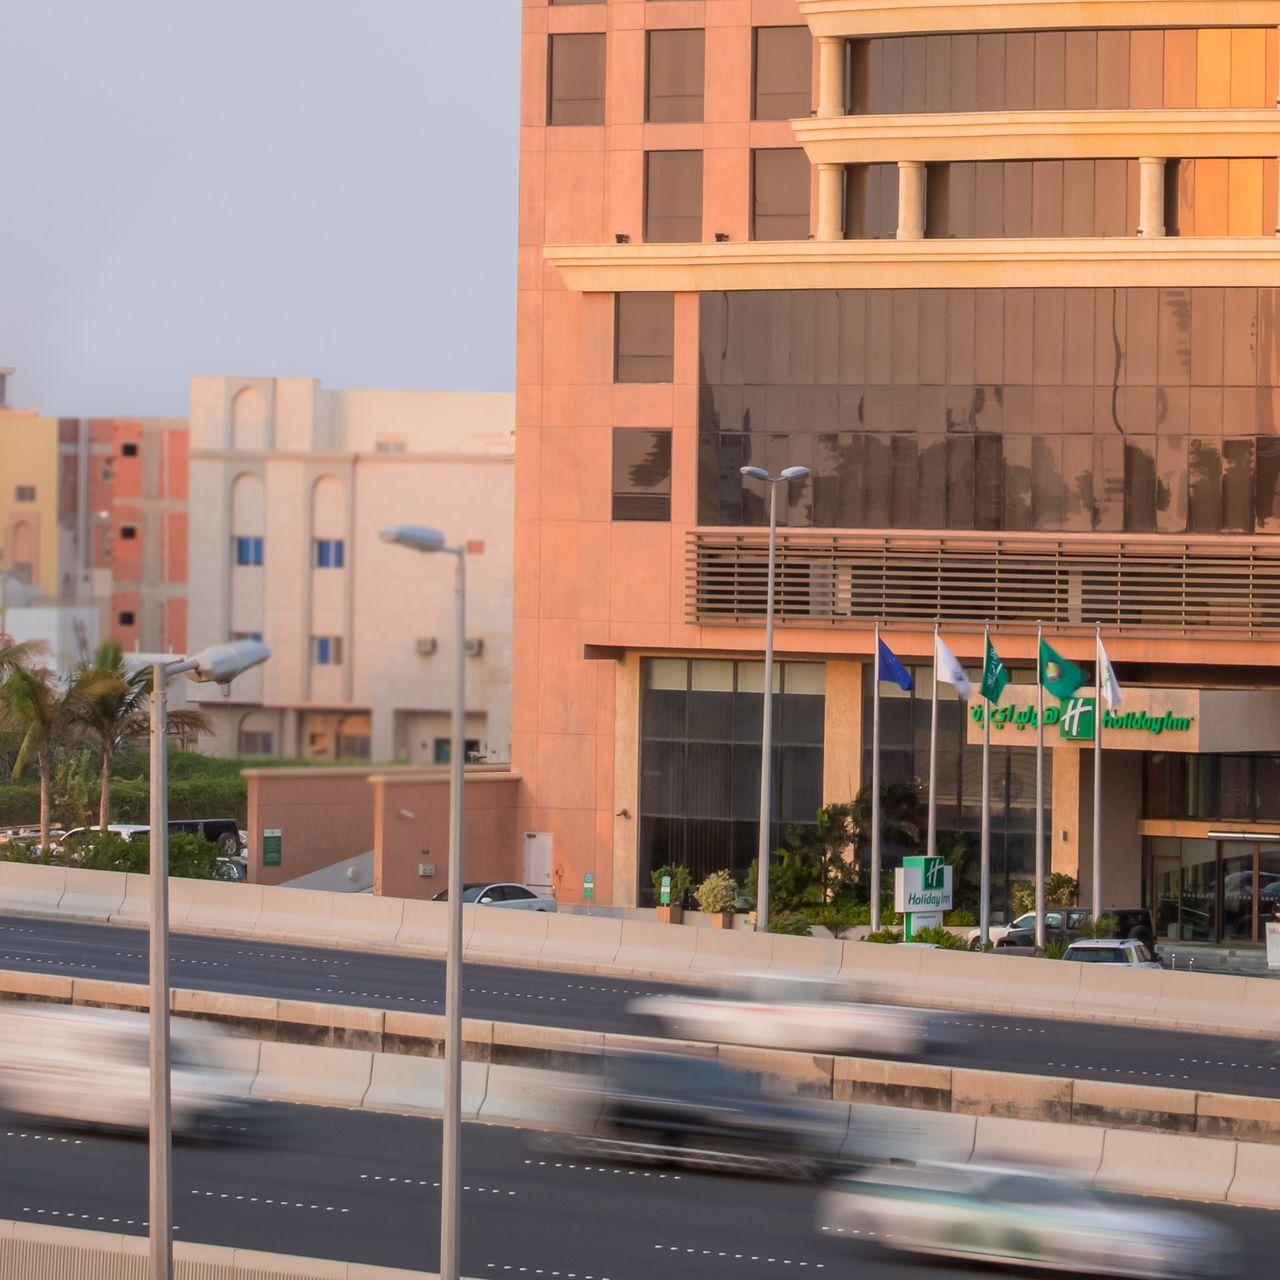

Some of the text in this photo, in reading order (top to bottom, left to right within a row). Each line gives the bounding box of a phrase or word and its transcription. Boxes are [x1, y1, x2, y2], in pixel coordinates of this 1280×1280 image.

[1102, 709, 1191, 735] Holiday Inn
[908, 891, 950, 907] Holiday Inn
